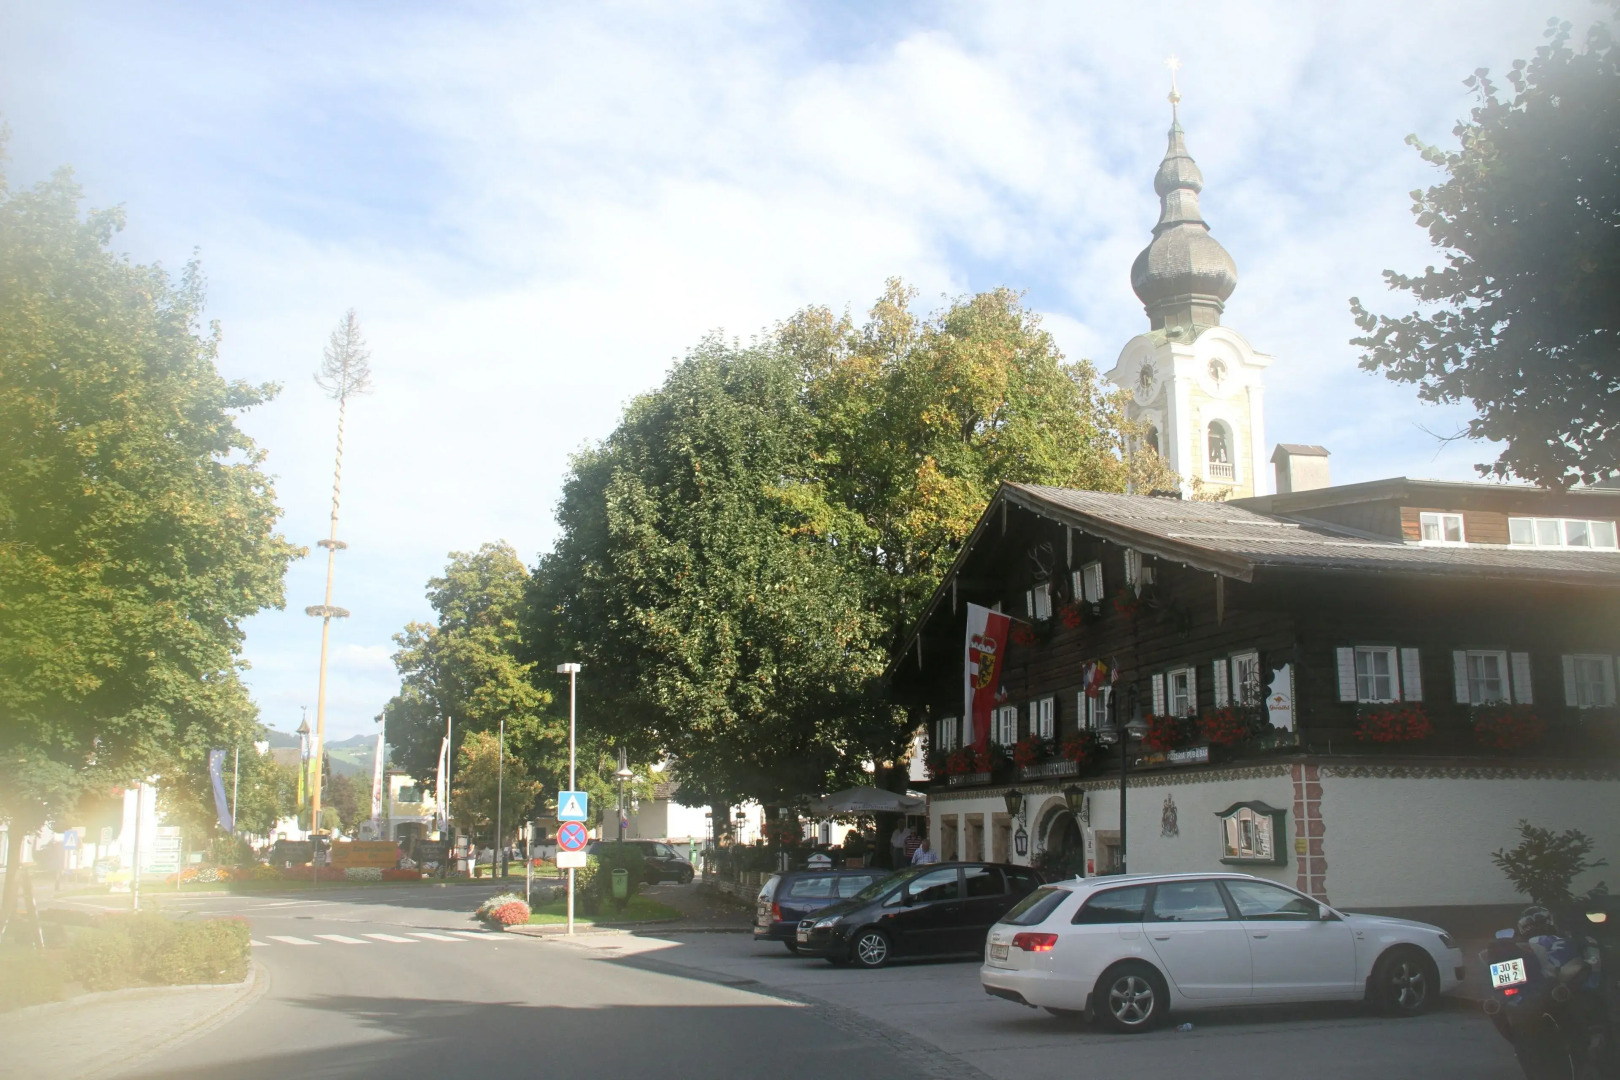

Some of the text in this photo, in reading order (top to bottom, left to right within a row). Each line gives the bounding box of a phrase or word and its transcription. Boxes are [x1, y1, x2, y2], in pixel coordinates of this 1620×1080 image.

[1499, 963, 1511, 973] JO
[1499, 971, 1519, 984] BH 2
